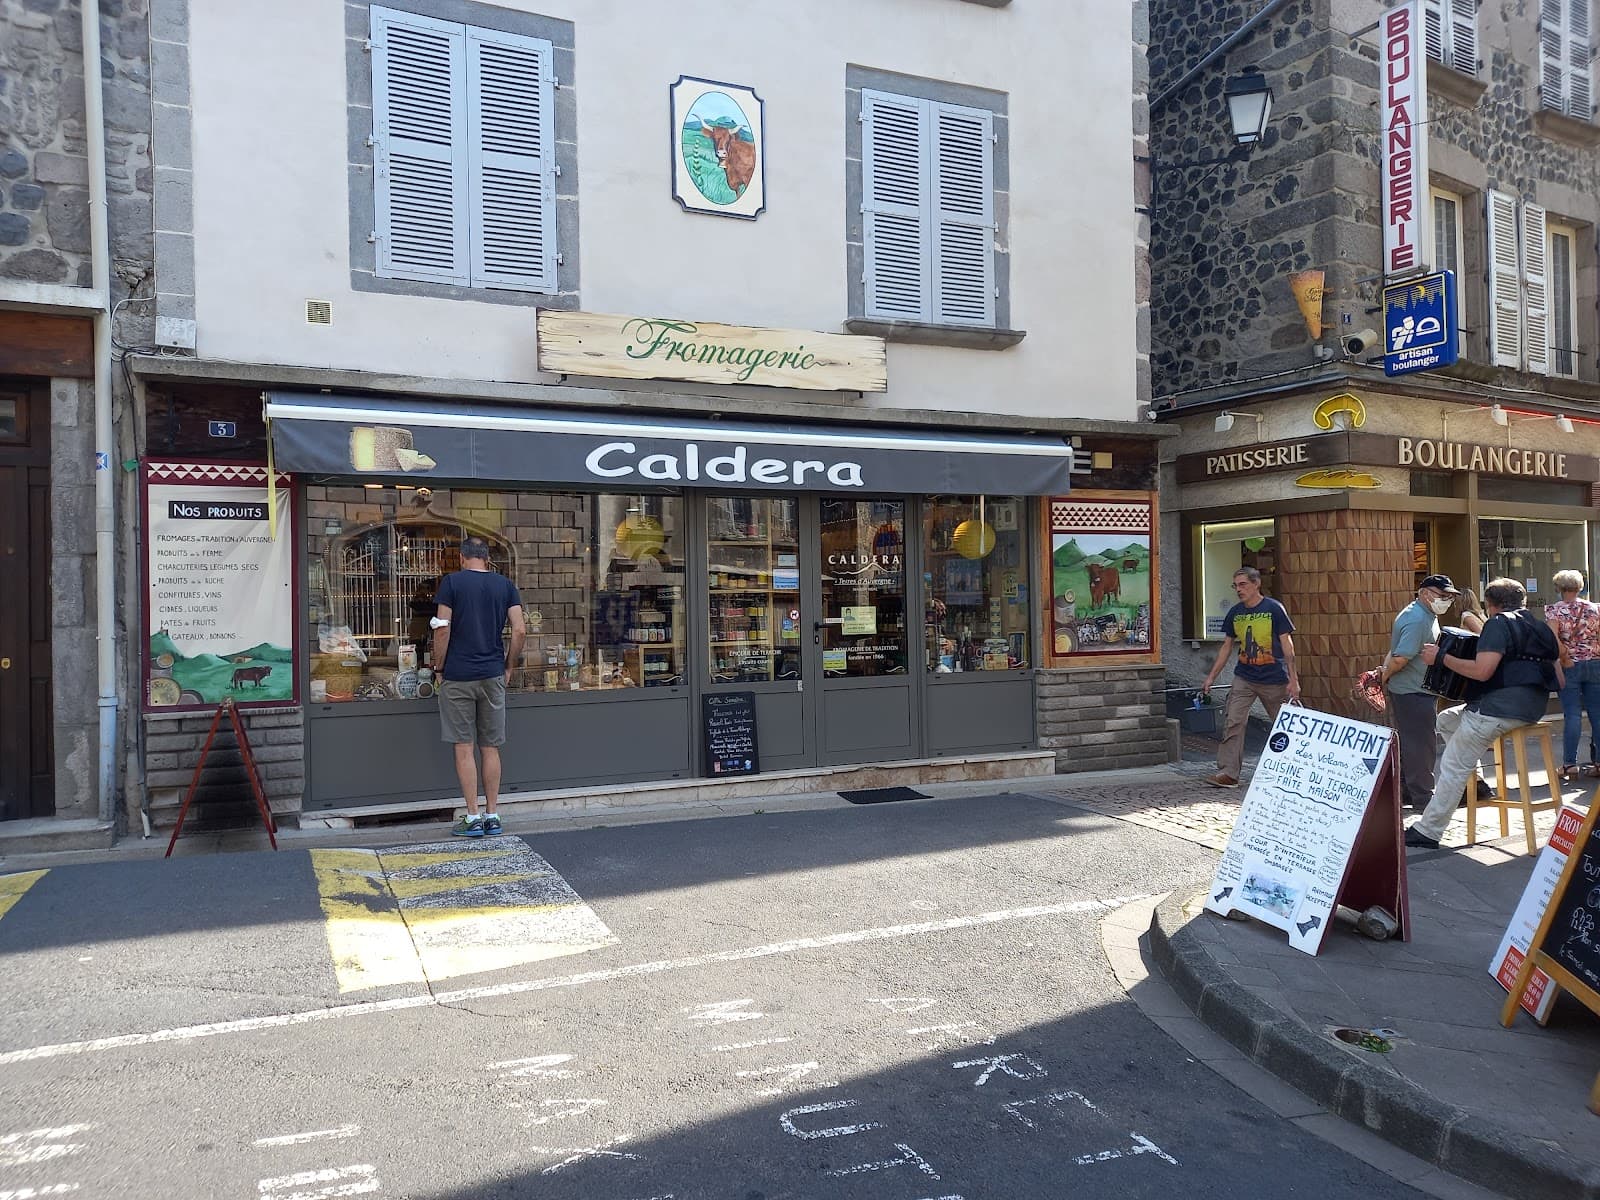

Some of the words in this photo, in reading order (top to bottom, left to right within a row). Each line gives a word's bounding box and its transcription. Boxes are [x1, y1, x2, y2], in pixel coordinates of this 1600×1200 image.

[1387, 8, 1414, 271] BOULANGERIE
[621, 318, 826, 381] Fromagerie
[1392, 355, 1440, 370] boulanger
[1399, 348, 1433, 360] artisan
[217, 423, 227, 436] 3
[585, 442, 864, 486] Caldera
[1206, 443, 1309, 474] PATISSERIE
[1398, 438, 1569, 478] BOULANGERIE
[173, 504, 200, 518] Nos
[208, 507, 262, 518] PRODUITS
[828, 555, 900, 564] CALDERA
[1276, 712, 1390, 757] RESTAURANT
[1295, 740, 1313, 757] Les
[1317, 751, 1349, 767] Volcans
[1263, 758, 1304, 778] CUISINE
[1308, 772, 1323, 784] DU
[1328, 778, 1368, 802] TERROIR
[1276, 774, 1303, 790] FAITE
[1308, 784, 1341, 801] MAISON
[1250, 836, 1268, 846] COUR
